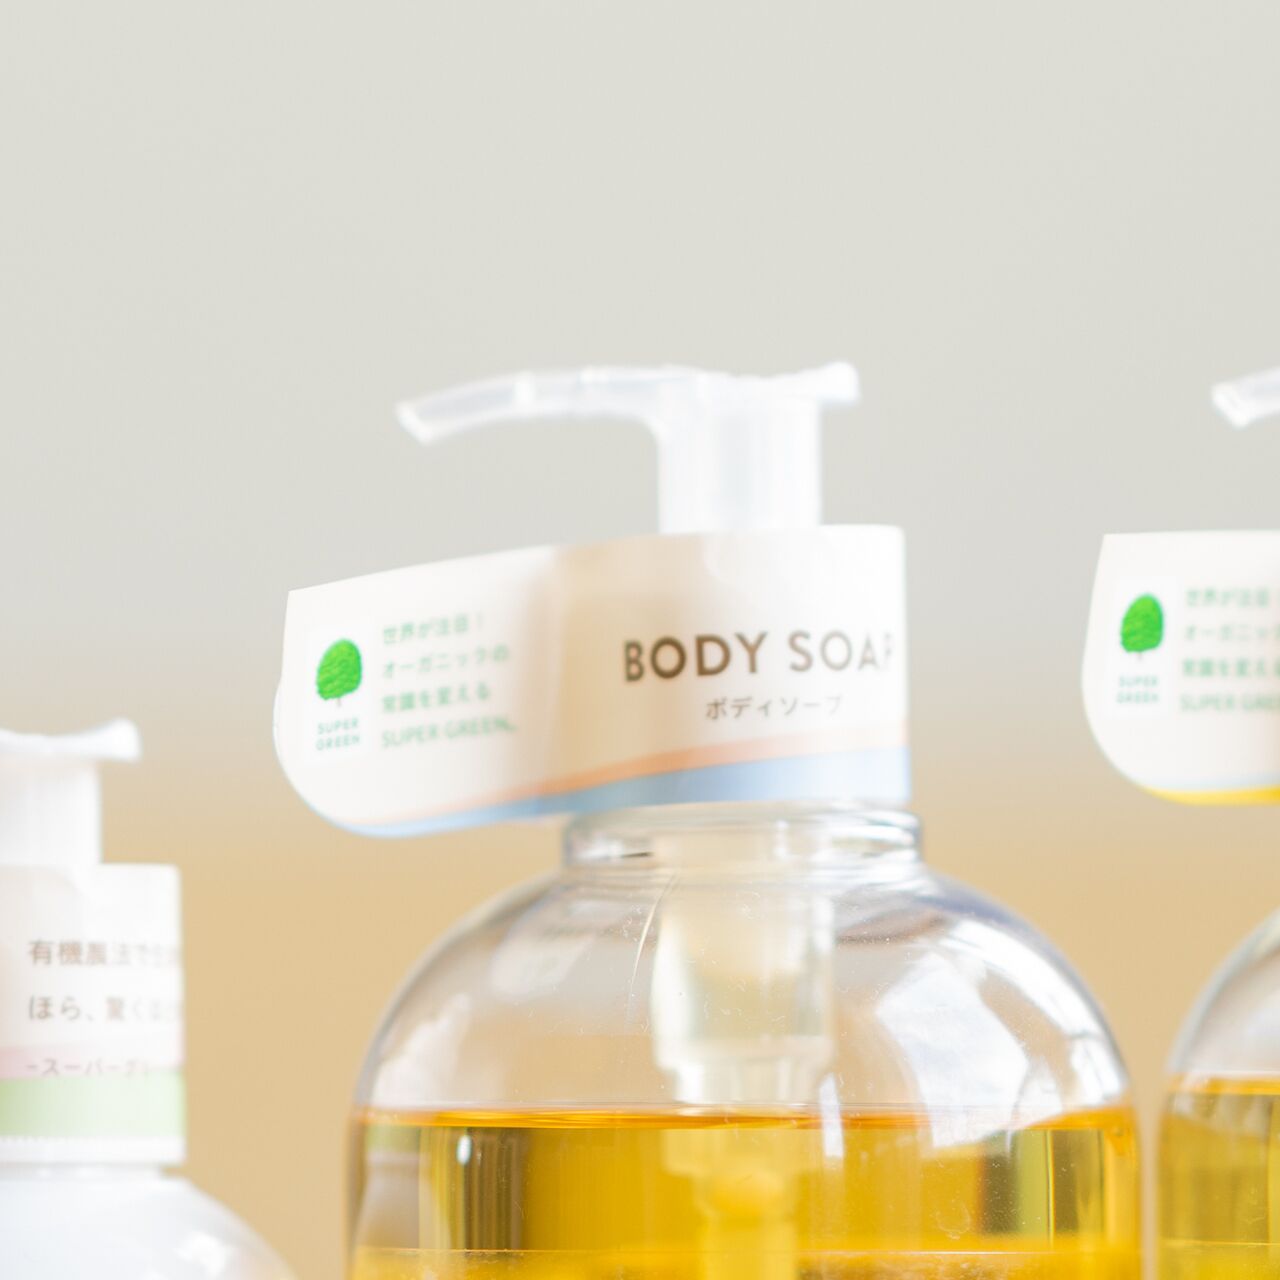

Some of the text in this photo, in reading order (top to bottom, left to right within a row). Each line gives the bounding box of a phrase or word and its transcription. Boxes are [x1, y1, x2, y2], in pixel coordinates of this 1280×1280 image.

[624, 631, 769, 684] BODY
[317, 717, 360, 735] SUPER
[381, 722, 440, 750] SUPER
[315, 733, 362, 751] GREEN
